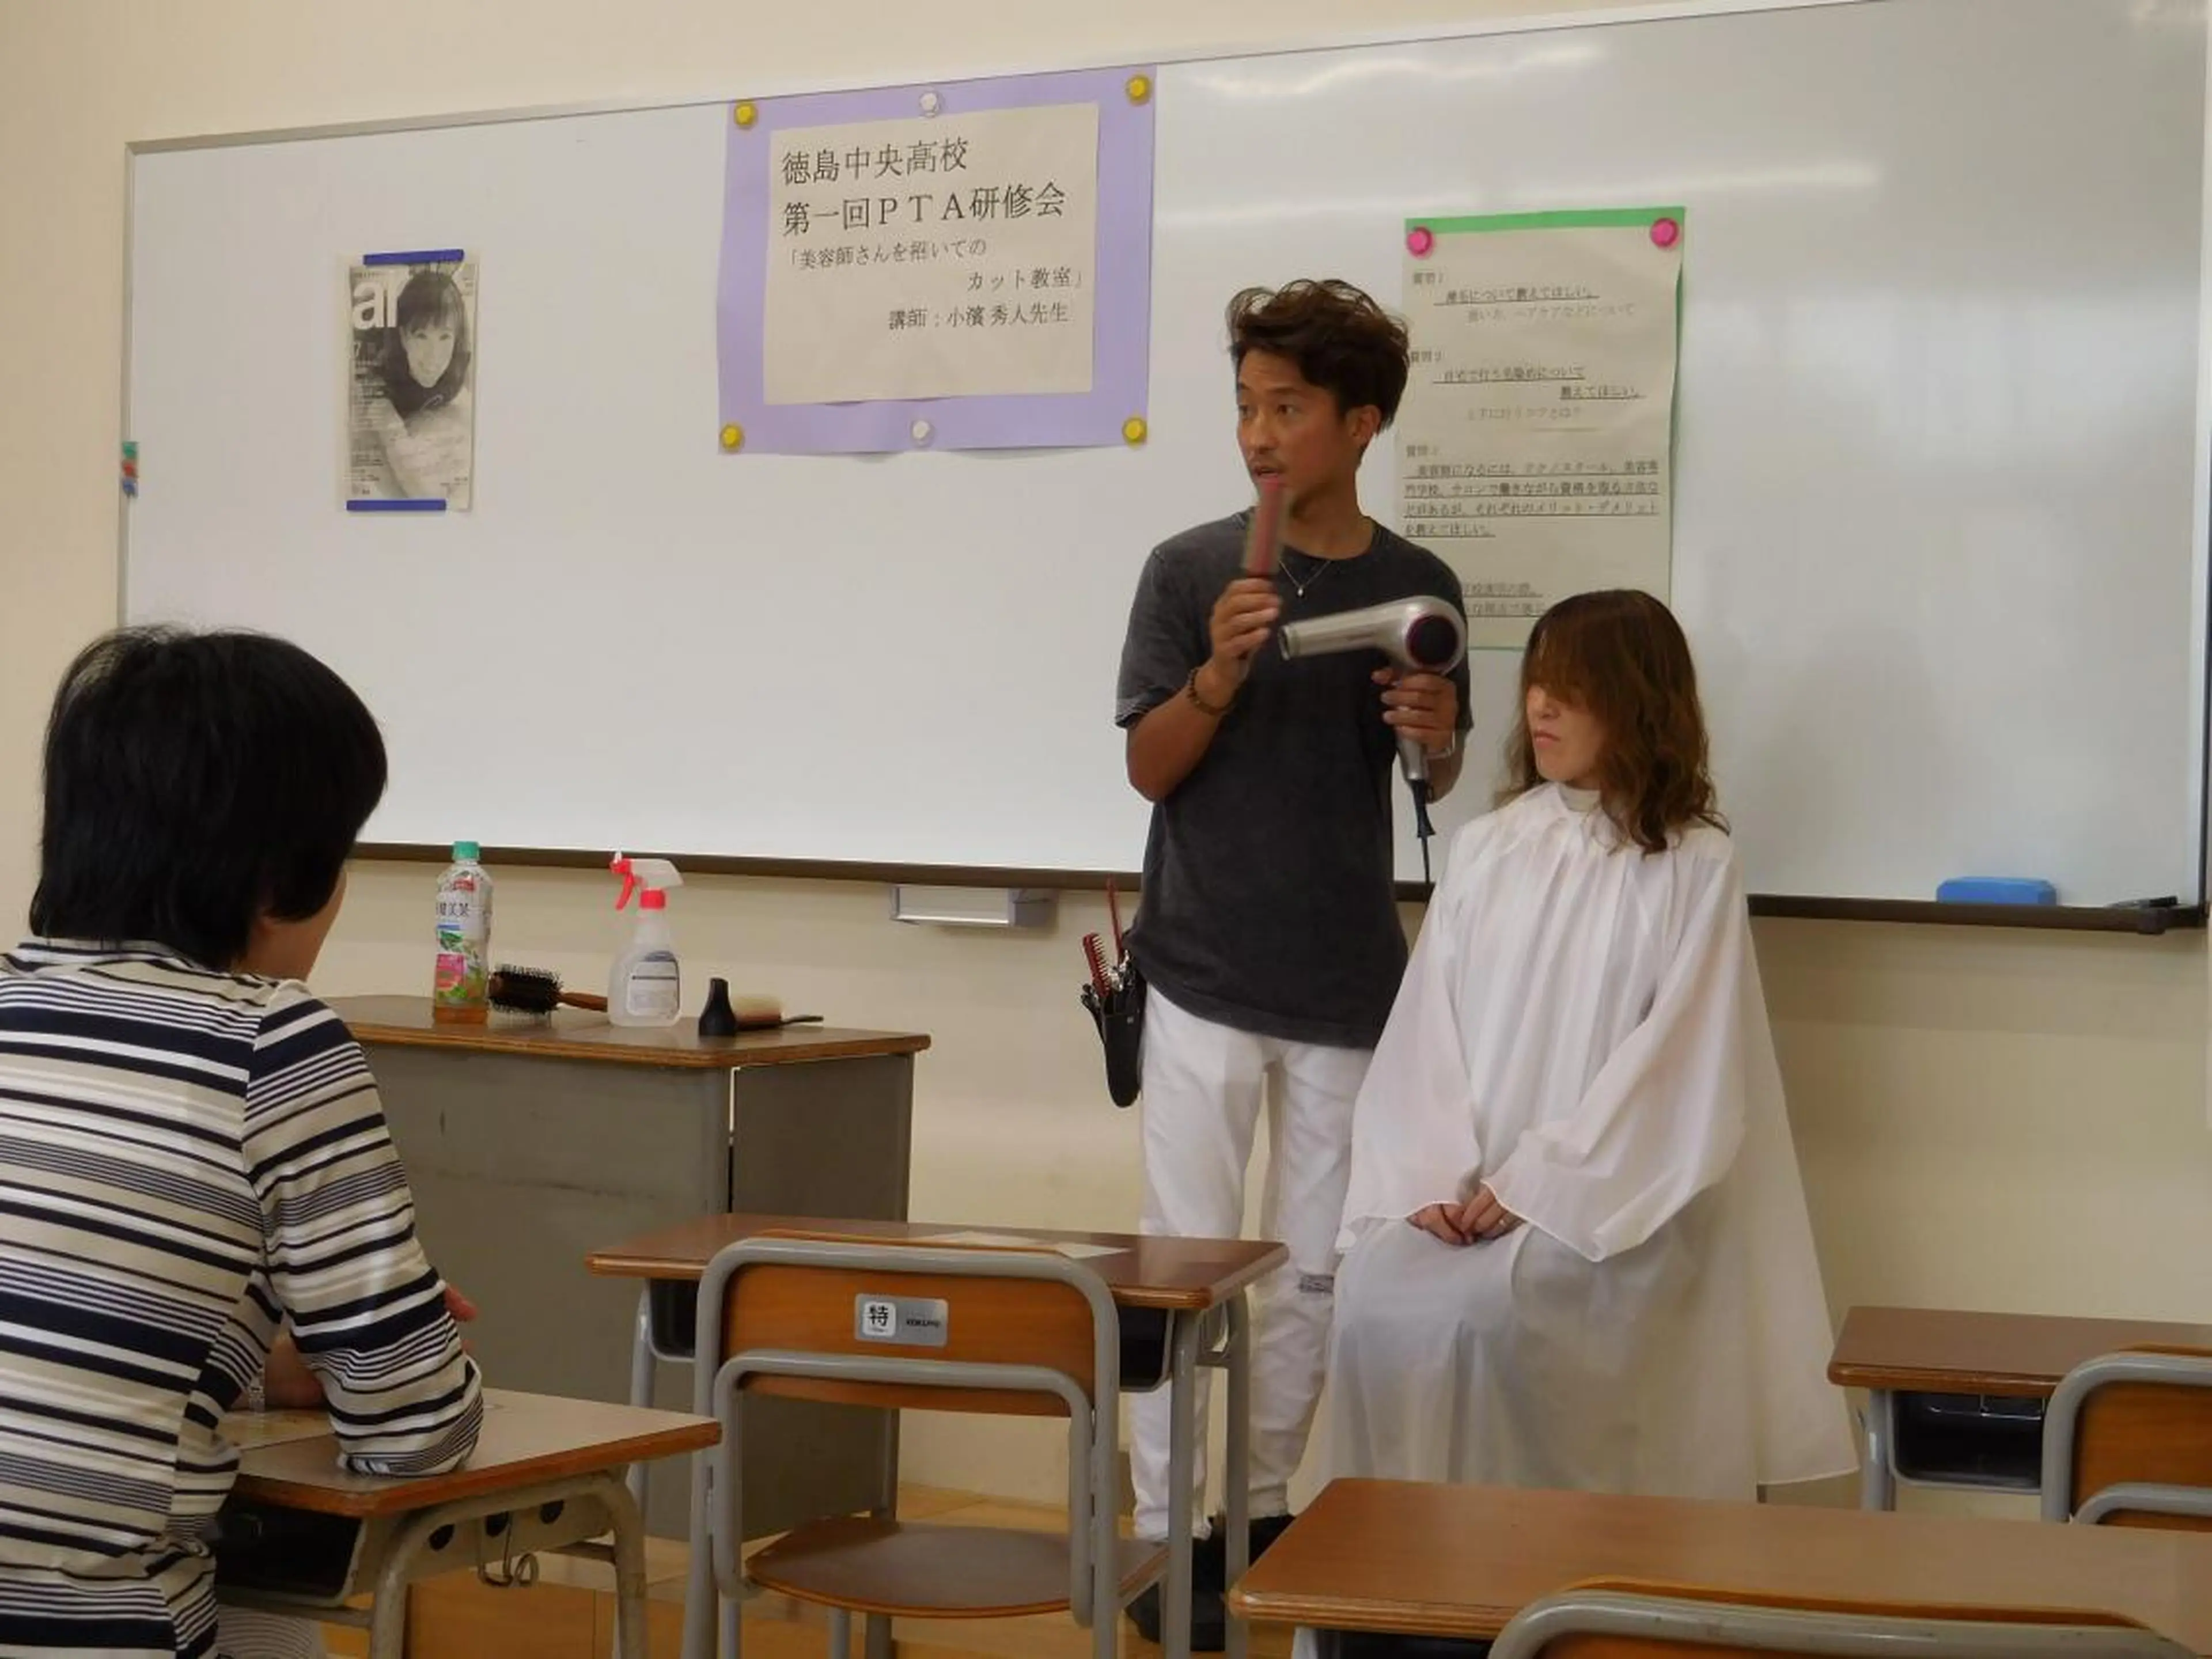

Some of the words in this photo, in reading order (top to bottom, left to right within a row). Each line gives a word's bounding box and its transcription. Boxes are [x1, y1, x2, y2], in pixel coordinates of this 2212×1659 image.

[782, 137, 969, 185] 徳島中央高校
[790, 238, 987, 270] 「美容師さんを招いての
[967, 266, 1084, 291] カット教室」
[868, 1304, 889, 1326] 特
